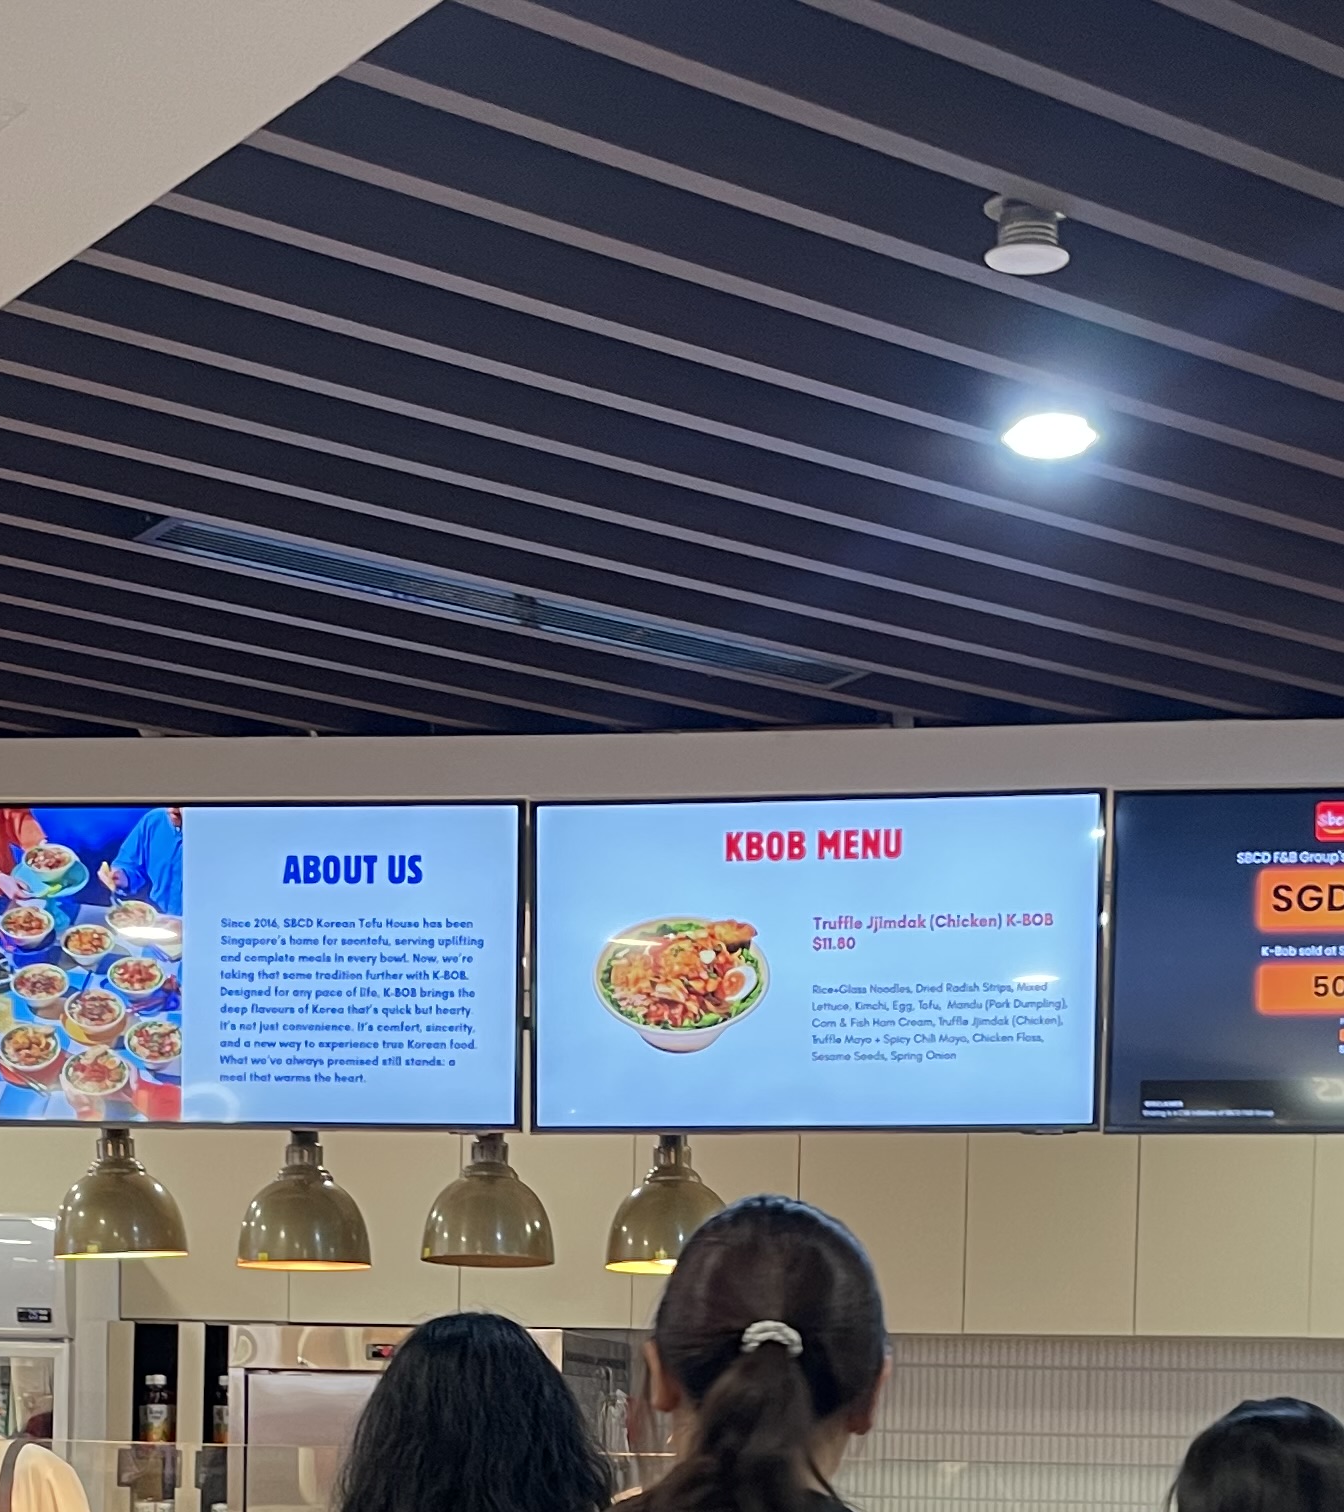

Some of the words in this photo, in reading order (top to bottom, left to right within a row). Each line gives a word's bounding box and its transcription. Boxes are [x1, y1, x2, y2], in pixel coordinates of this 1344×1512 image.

[725, 830, 806, 862] KBOB
[817, 828, 903, 860] MENU
[1236, 851, 1272, 864] SBCD
[1273, 851, 1297, 864] F&B
[283, 855, 378, 885] ABOUT
[388, 855, 423, 885] US
[220, 918, 251, 928] Since
[284, 918, 313, 928] SBCD
[316, 918, 356, 928] Korean
[358, 918, 383, 928] Tofu
[386, 918, 419, 928] House
[423, 918, 442, 928] has
[446, 918, 474, 928] been
[813, 915, 863, 930] Truffle
[866, 914, 927, 933] Jjimdak
[929, 913, 1002, 931] (Chicken)
[1006, 913, 1054, 927] K-BOB
[220, 935, 286, 948] Singapore's
[290, 935, 319, 945] home
[395, 936, 434, 948] serving
[438, 935, 484, 949] uplifting
[812, 936, 856, 951] $11.80
[1261, 945, 1297, 957] K-Bob
[1299, 945, 1322, 957] sold
[220, 952, 241, 962] and
[244, 952, 295, 965] complete
[298, 952, 331, 962] meals
[347, 955, 377, 966] every
[380, 952, 409, 963] bowl.
[413, 953, 439, 964] Now,
[442, 953, 474, 963] we're
[220, 969, 254, 982] taking
[258, 969, 279, 980] that
[282, 971, 312, 980] same
[315, 969, 362, 980] tradition
[365, 969, 403, 980] further
[406, 970, 429, 980] with
[220, 986, 271, 999] Designed
[315, 988, 342, 1000] pace
[383, 987, 416, 998] K-BOB
[420, 987, 454, 1000] brings
[869, 983, 912, 994] Noodles,
[915, 983, 943, 993] Dried
[946, 982, 980, 993] Radish
[982, 982, 1014, 994] Strips,
[1017, 982, 1048, 992] Mixed
[220, 1003, 248, 1016] deep
[251, 1003, 295, 1014] flavours
[312, 1004, 344, 1014] Korea
[348, 1004, 378, 1015] that's
[382, 1004, 412, 1018] quick
[855, 1001, 889, 1012] Kimchi,
[892, 1001, 915, 1013] Egg,
[947, 1000, 983, 1010] Mandu
[985, 999, 1010, 1011] (Pork
[259, 1020, 279, 1034] just
[377, 1021, 422, 1033] comfort,
[850, 1017, 870, 1027] Fish
[873, 1017, 895, 1027] Ham
[898, 1017, 936, 1027] Cream,
[938, 1016, 969, 1027] Truffle
[971, 1015, 1009, 1028] Jjimdak
[220, 1037, 240, 1048] and
[279, 1040, 301, 1051] way
[318, 1039, 378, 1051] experience
[382, 1040, 404, 1049] true
[407, 1039, 447, 1049] Korean
[811, 1034, 841, 1044] Truffle
[844, 1034, 872, 1046] Mayo
[883, 1034, 911, 1046] Spicy
[972, 1033, 1014, 1043] Chicken
[220, 1055, 248, 1065] What
[285, 1055, 324, 1068] always
[327, 1056, 379, 1068] promised
[382, 1056, 401, 1066] still
[811, 1051, 851, 1061] Sesame
[890, 1051, 923, 1063] Spring
[925, 1050, 957, 1060] Onion
[220, 1072, 246, 1082] meal
[250, 1072, 271, 1082] that
[274, 1073, 311, 1082] warms
